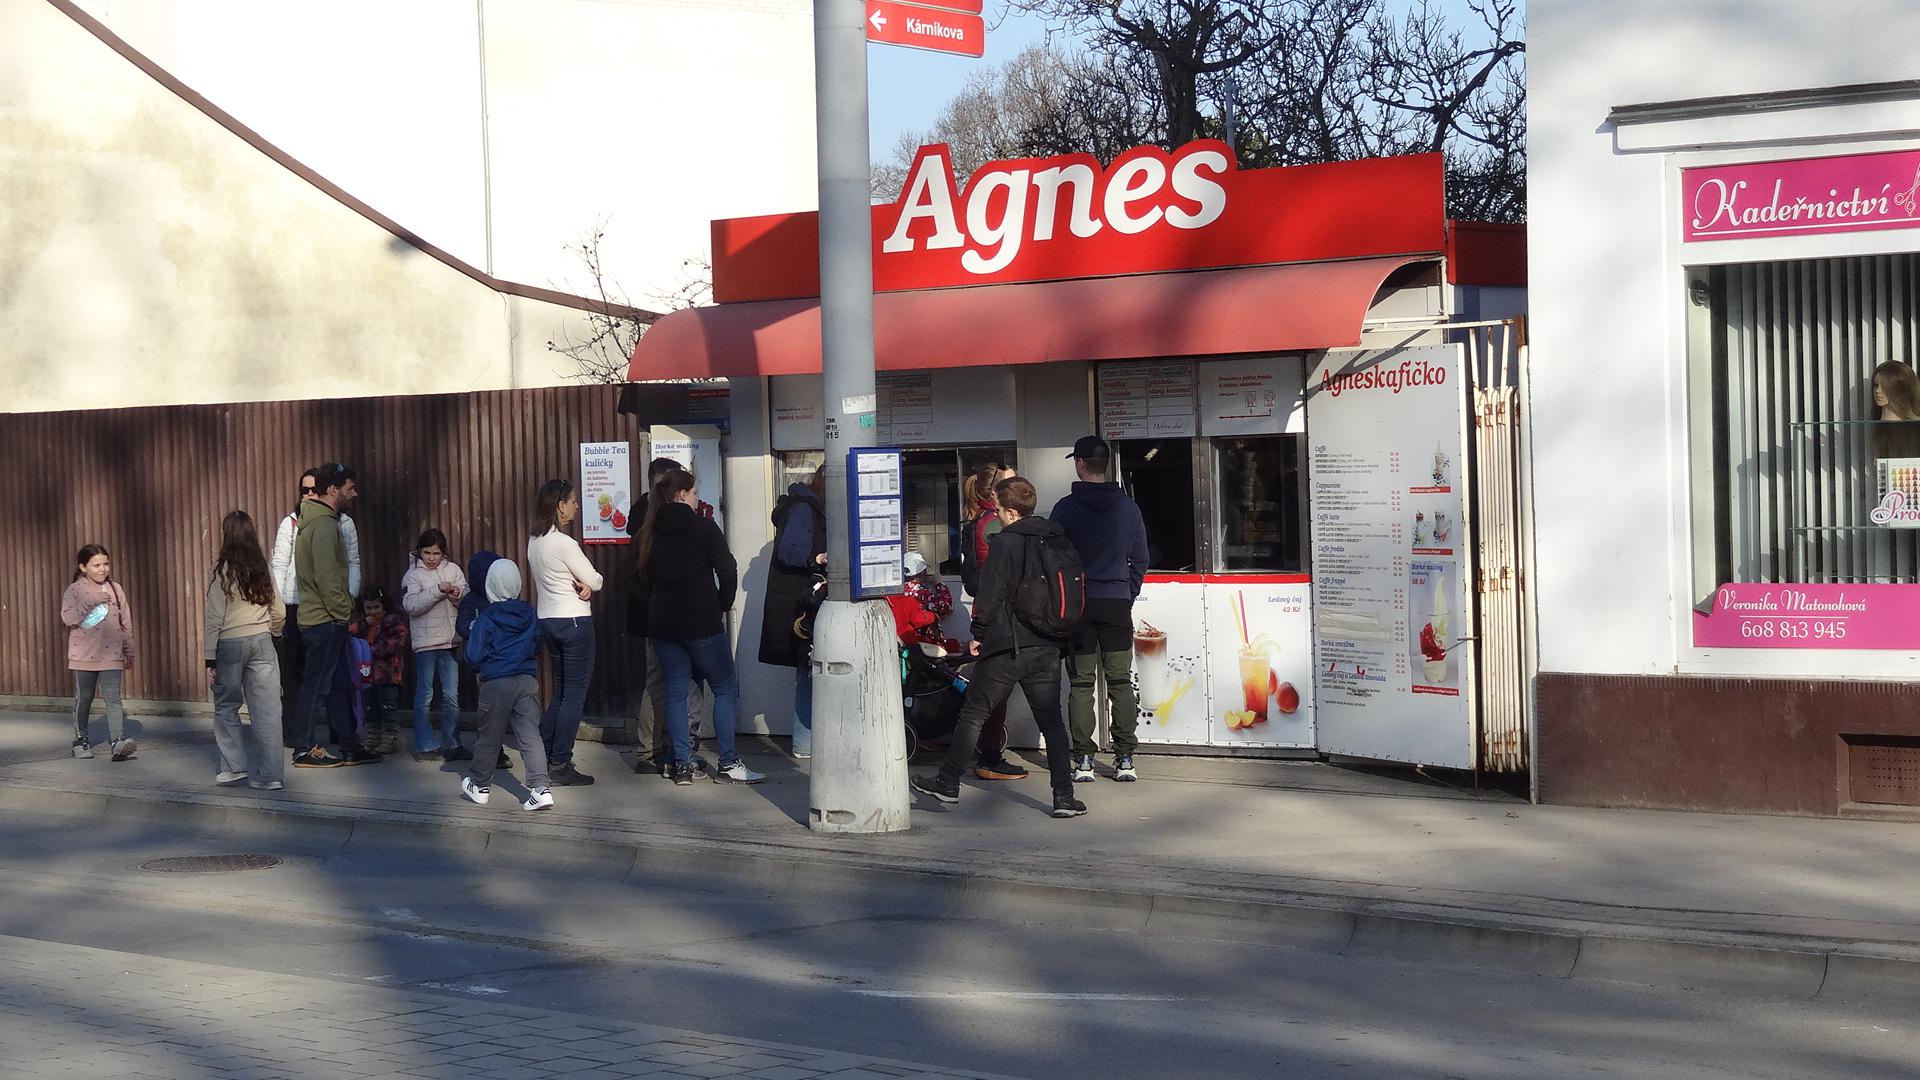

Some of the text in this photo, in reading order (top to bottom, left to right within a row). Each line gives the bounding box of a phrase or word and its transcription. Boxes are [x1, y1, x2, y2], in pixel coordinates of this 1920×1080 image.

[883, 150, 1228, 275] Agnes
[1692, 178, 1891, 229] Kadeřnictví
[1319, 360, 1446, 397] Agneskafíčko
[585, 459, 613, 468] kulíčky
[1718, 589, 1866, 611] Veronika Matonohová
[1742, 622, 1845, 638] 608 813 945
